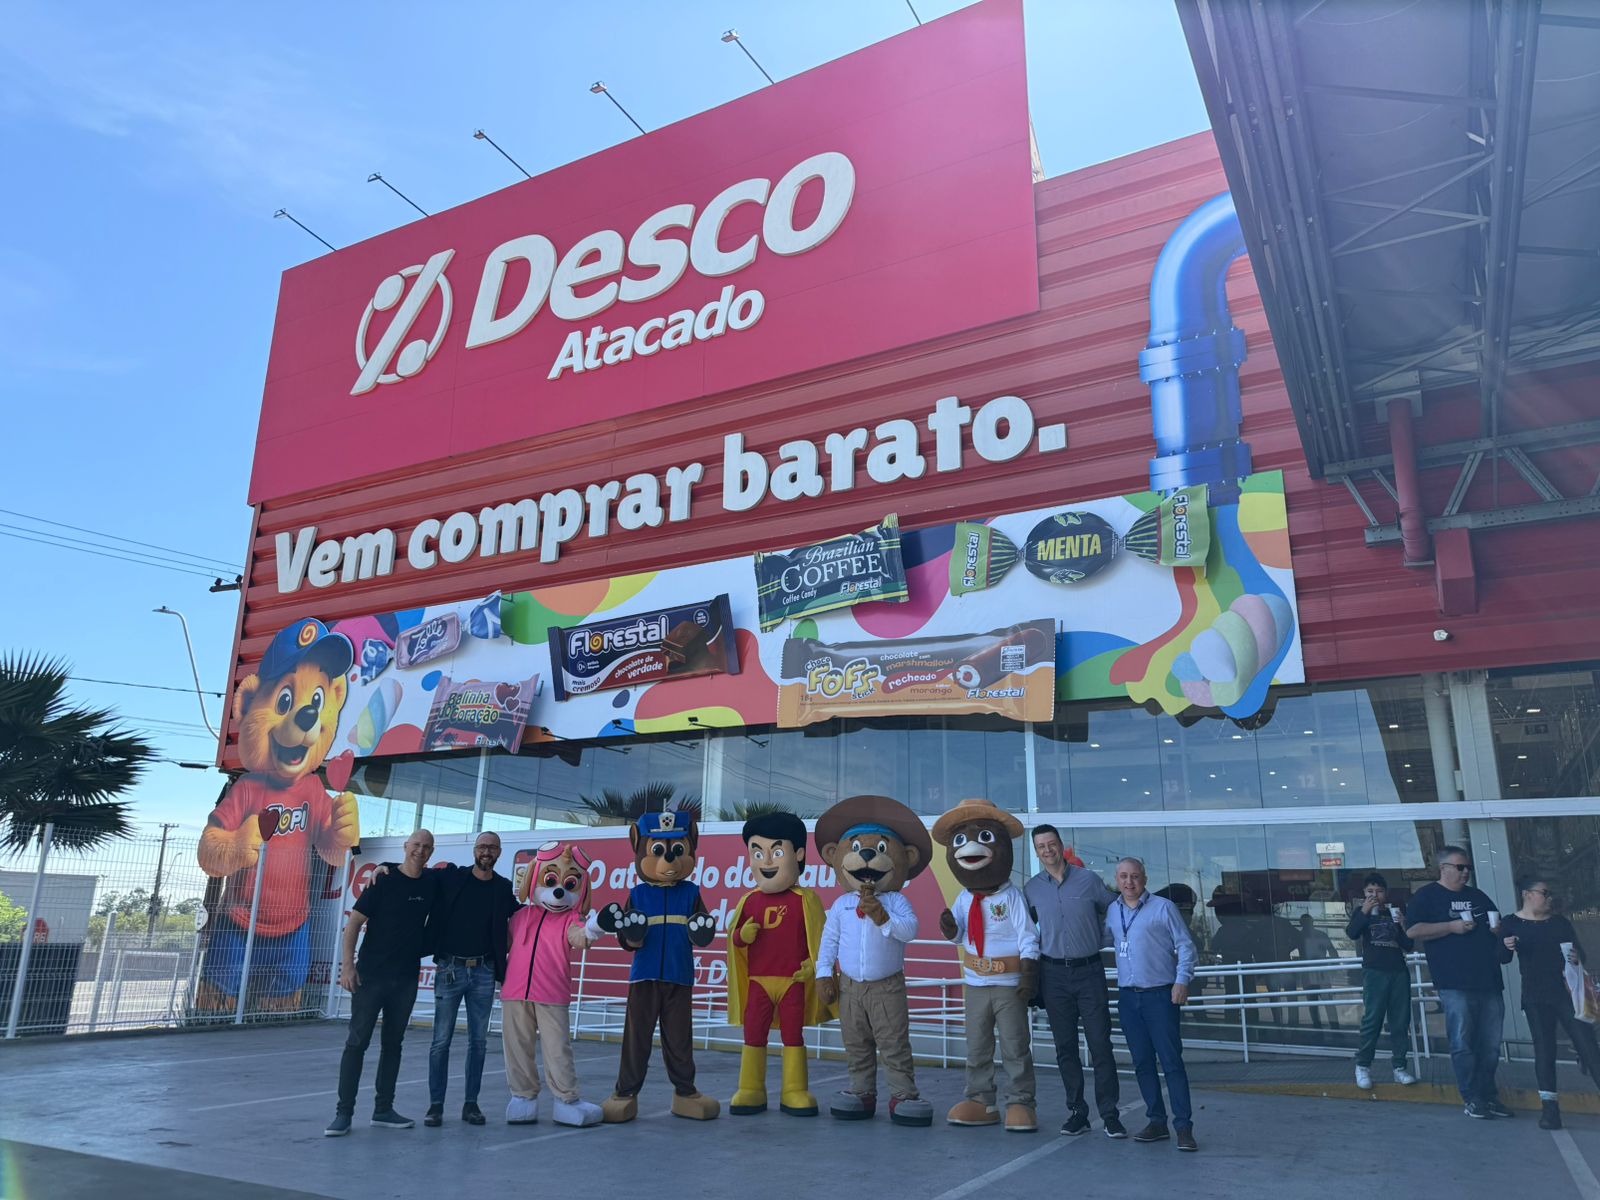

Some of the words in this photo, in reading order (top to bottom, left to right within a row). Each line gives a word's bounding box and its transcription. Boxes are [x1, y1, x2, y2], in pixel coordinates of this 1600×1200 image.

[464, 152, 856, 350] Desco
[547, 285, 766, 380] Atacado
[275, 526, 396, 593] Vem
[408, 463, 704, 564] comprar
[722, 396, 1068, 511] barato.
[1173, 493, 1193, 559] Florestal
[803, 540, 875, 566] Brazilian
[1036, 533, 1102, 561] MENTA
[963, 531, 980, 588] Florestal
[780, 553, 882, 593] COFFEE
[840, 577, 882, 594] Florestal
[782, 591, 800, 605] Coffee
[801, 589, 818, 600] Candy
[570, 615, 668, 658] Florestal
[614, 655, 645, 679] chocolate
[645, 655, 654, 663] de
[880, 651, 919, 661] chocolate
[885, 657, 954, 671] marshmallow
[627, 661, 664, 680] verdade
[888, 672, 937, 689] recheado
[572, 678, 601, 692] cremoso
[910, 687, 953, 696] morango
[966, 687, 1025, 699] Florestal
[447, 690, 491, 706] Balinha
[449, 705, 499, 727] Coração
[609, 857, 719, 889] atdo
[1451, 901, 1472, 911] NIKE
